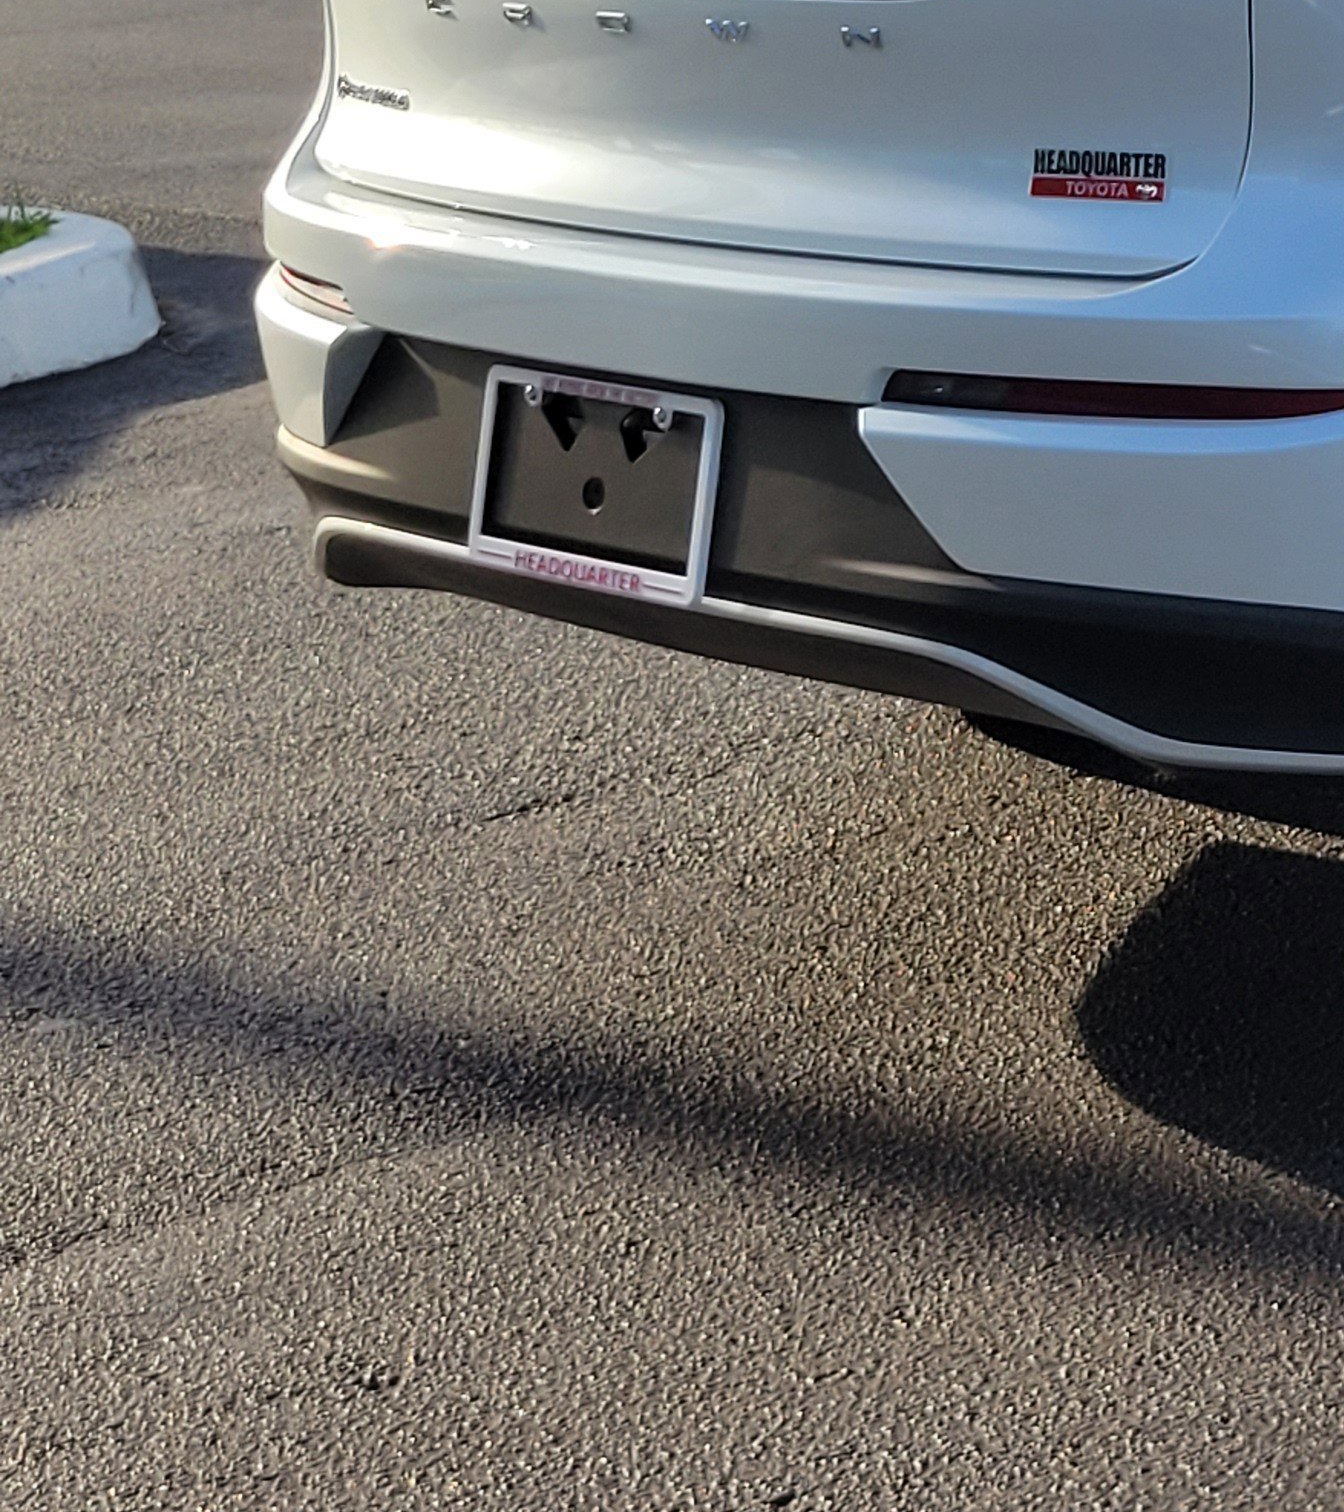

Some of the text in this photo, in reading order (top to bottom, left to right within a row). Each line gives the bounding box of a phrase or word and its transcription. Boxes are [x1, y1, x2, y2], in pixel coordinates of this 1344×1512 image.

[1033, 148, 1167, 179] HEADQUARTER
[1065, 180, 1129, 199] TOYOTA
[514, 549, 640, 593] HEADQUARTER
